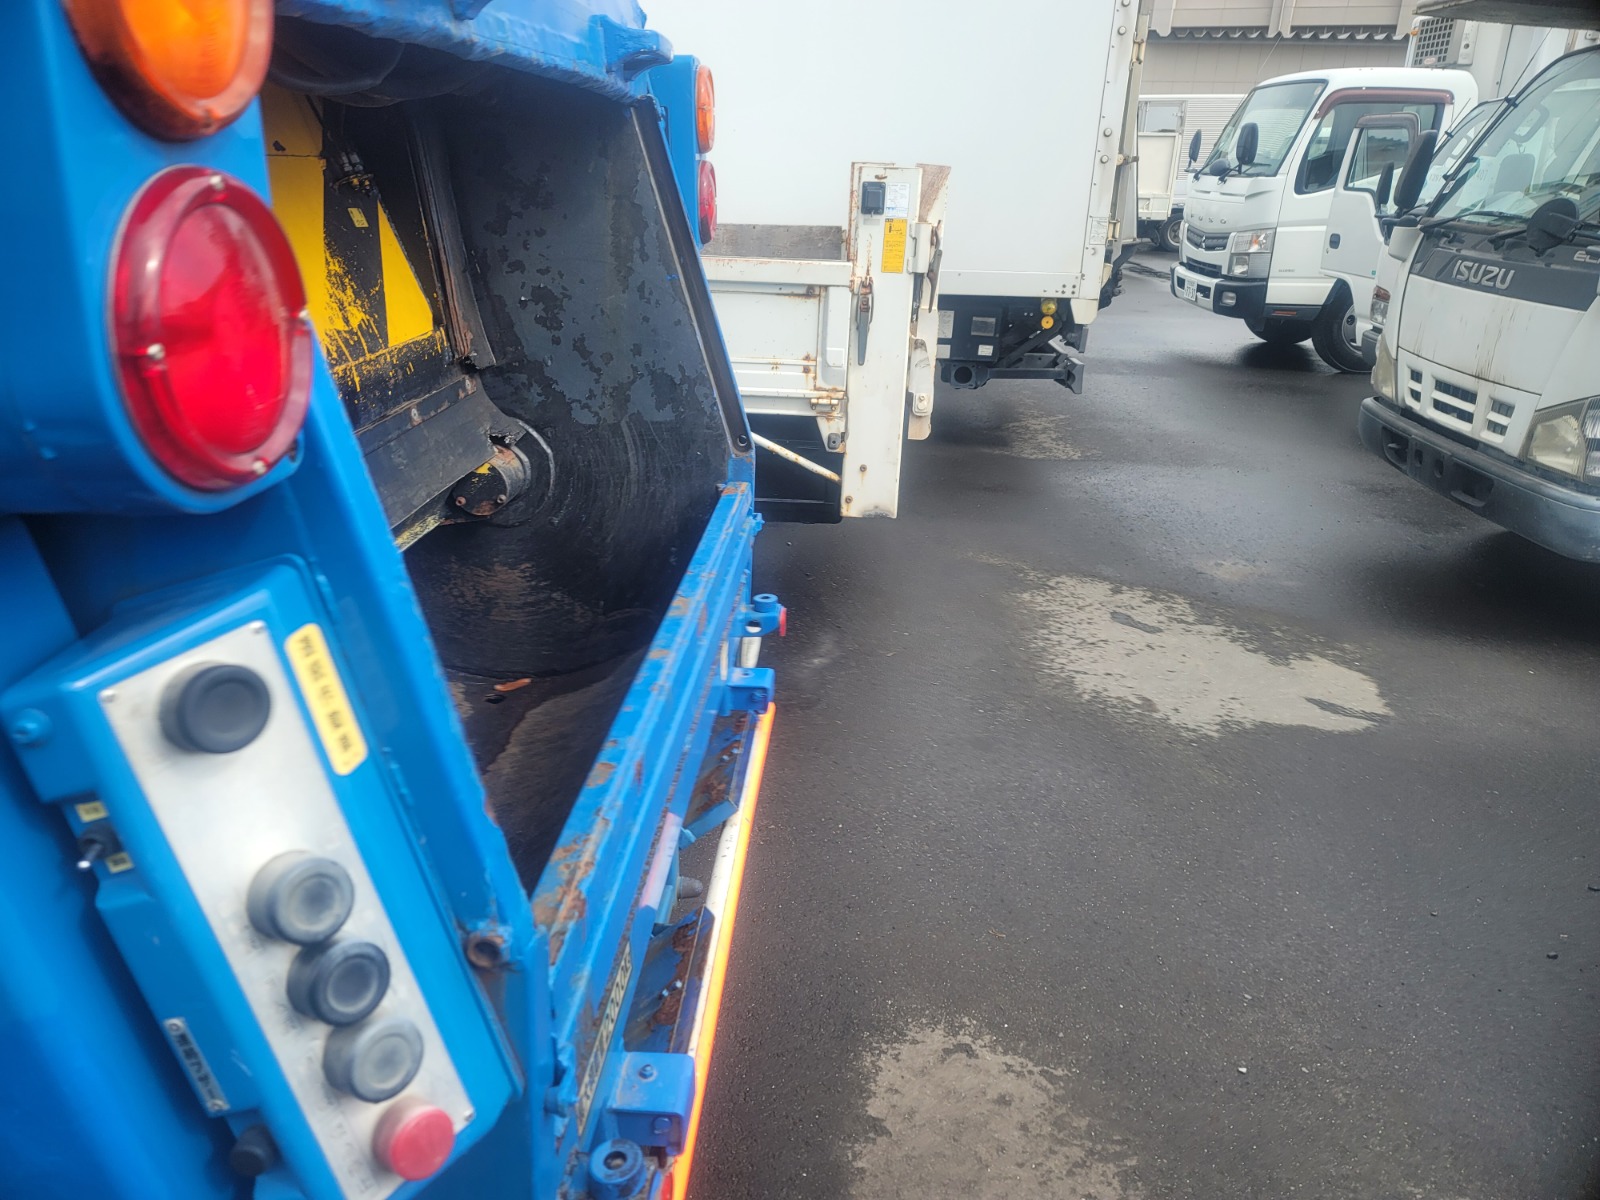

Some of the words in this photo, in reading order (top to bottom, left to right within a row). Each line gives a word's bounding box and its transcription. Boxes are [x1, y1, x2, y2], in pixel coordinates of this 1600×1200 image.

[1190, 213, 1227, 225] FUSO
[1573, 250, 1600, 264] EL
[1452, 260, 1515, 290] ISUZU
